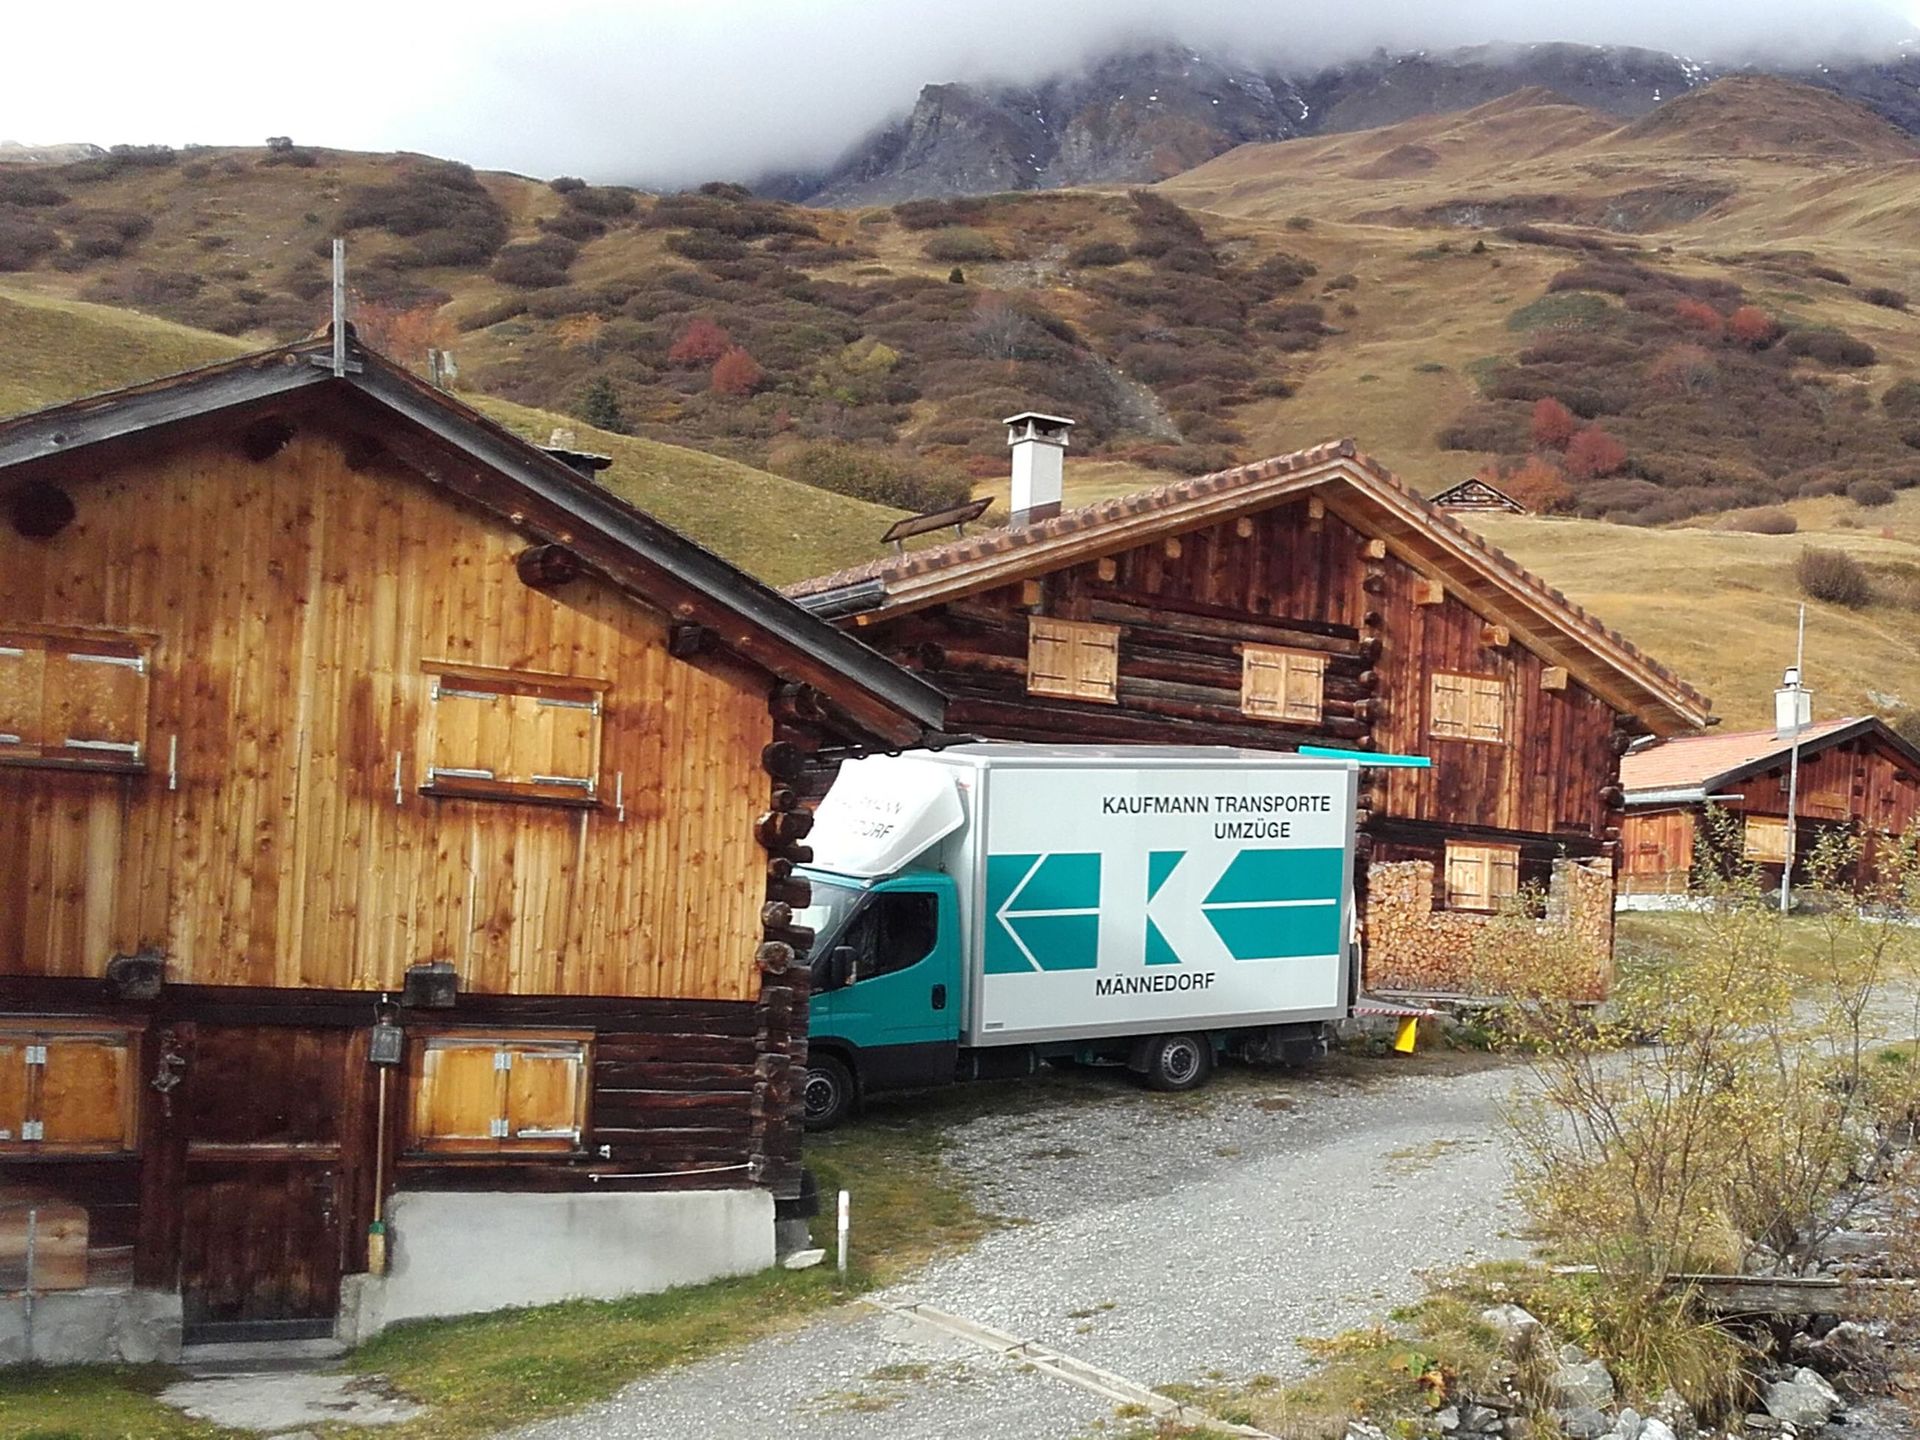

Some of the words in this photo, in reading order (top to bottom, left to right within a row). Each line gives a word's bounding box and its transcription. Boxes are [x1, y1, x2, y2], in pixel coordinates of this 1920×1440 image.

[1103, 796, 1209, 814] KAUFMANN
[1214, 795, 1331, 813] TRANSPORTE
[1214, 818, 1291, 839] UMZÜGE
[1095, 972, 1216, 996] MÄNNEDORF
